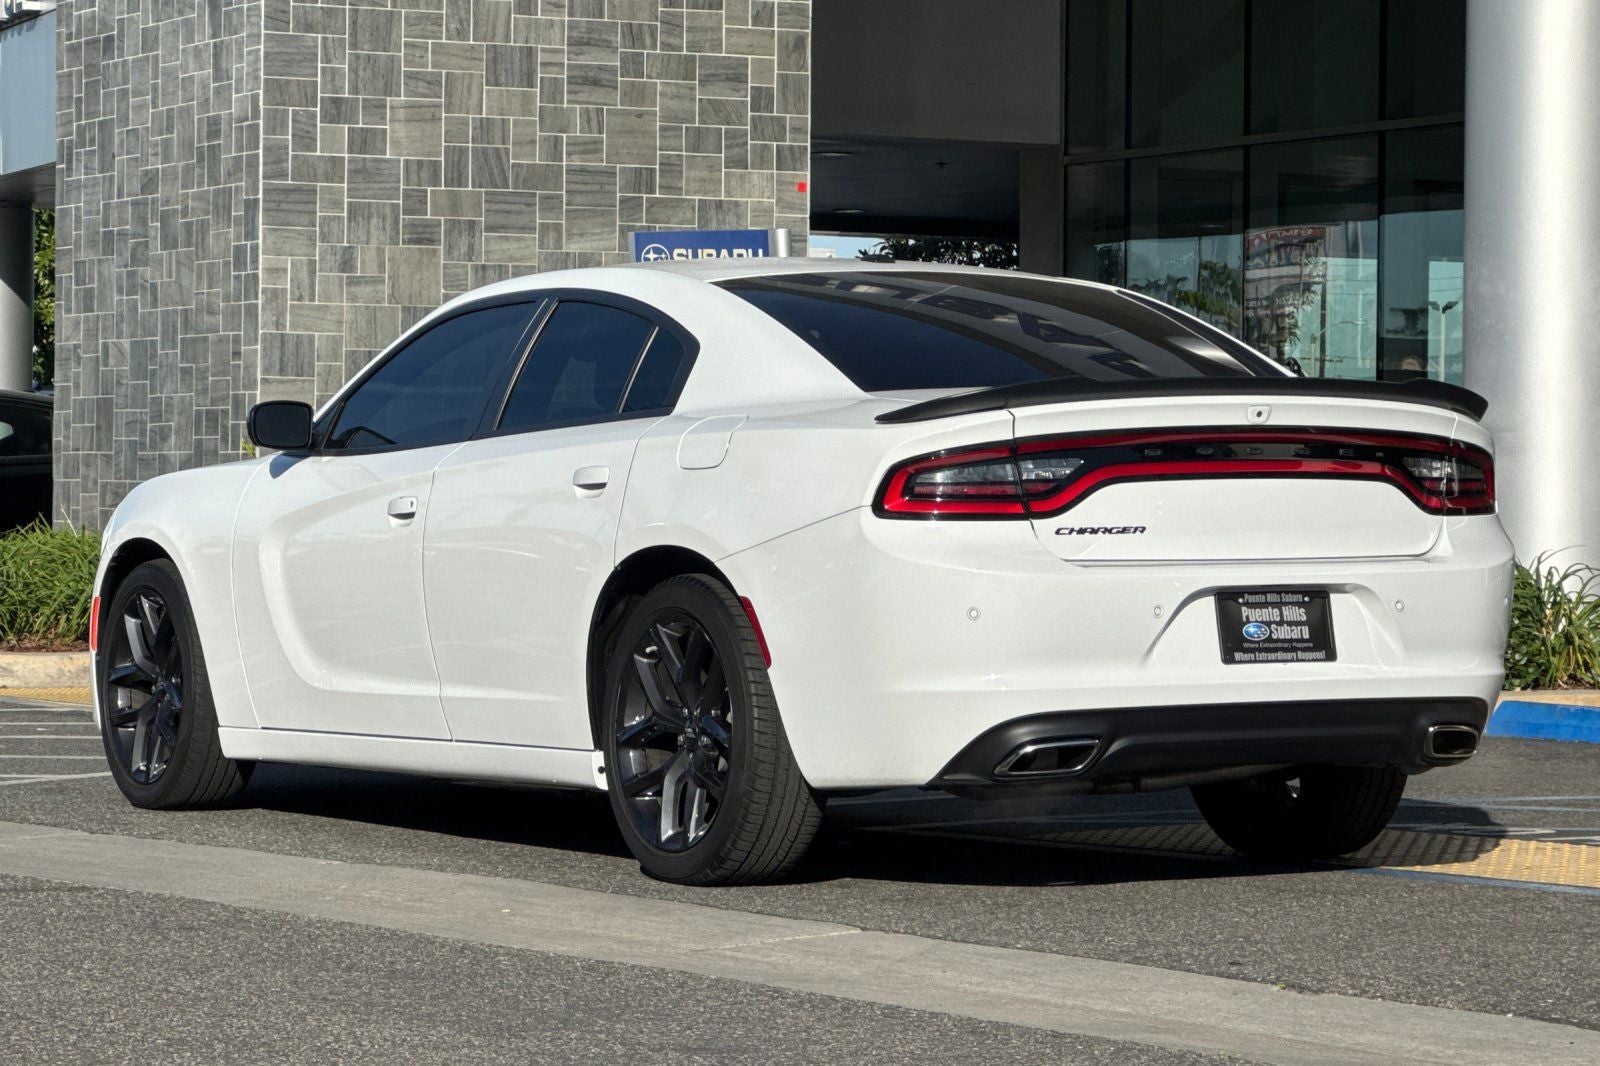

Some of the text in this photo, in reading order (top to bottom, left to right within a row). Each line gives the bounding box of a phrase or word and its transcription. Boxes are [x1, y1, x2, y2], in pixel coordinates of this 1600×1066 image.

[1055, 526, 1147, 535] CHARGER
[1244, 593, 1303, 602] Puente Hills Subaru
[1241, 605, 1306, 621] Puente Hills
[1271, 624, 1309, 639] Subaru
[1234, 650, 1326, 661] Where Extraordinary Happens!
